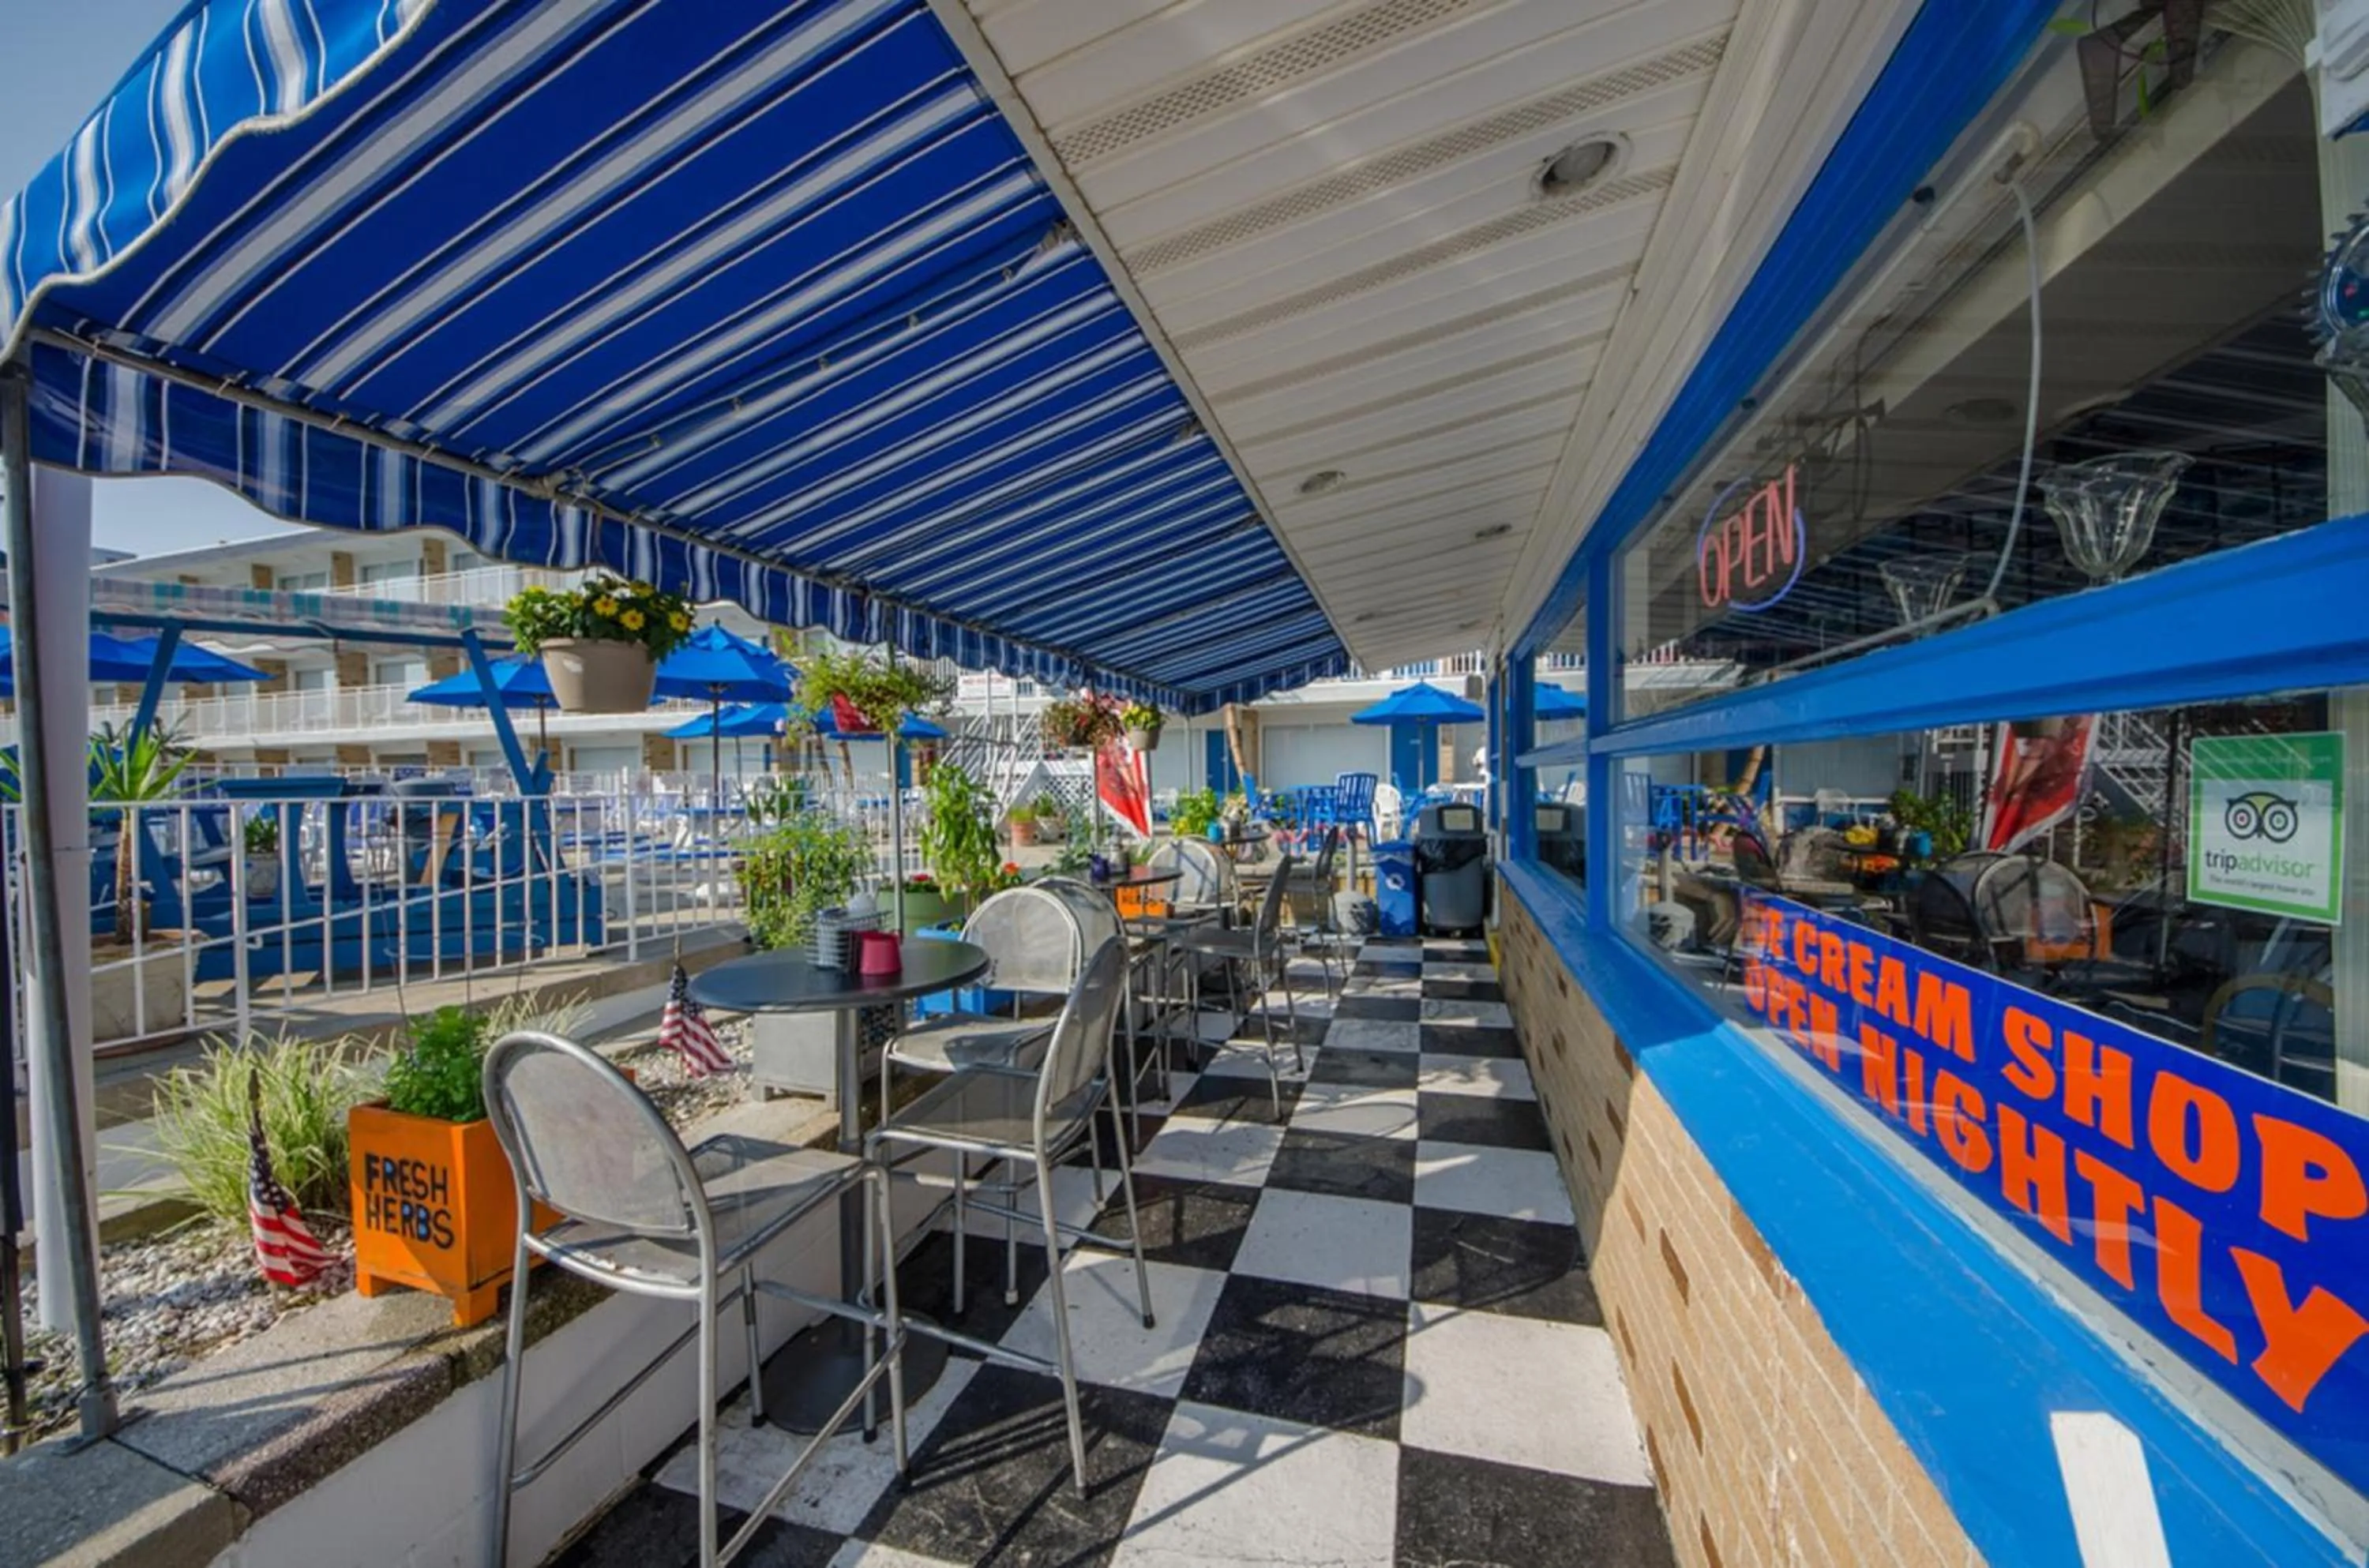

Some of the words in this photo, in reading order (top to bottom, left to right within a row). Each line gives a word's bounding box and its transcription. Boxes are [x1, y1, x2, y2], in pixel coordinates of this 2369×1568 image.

[1701, 463, 1794, 606] OPEN
[2205, 849, 2315, 878] tripadvisor
[1793, 919, 1975, 1063] CREAM
[2003, 1007, 2368, 1242] SHOP
[365, 1153, 448, 1204] FRESH
[366, 1194, 454, 1250] HERBS
[1744, 954, 1841, 1072] OPEN
[1859, 1026, 2369, 1413] NIGHTLY
